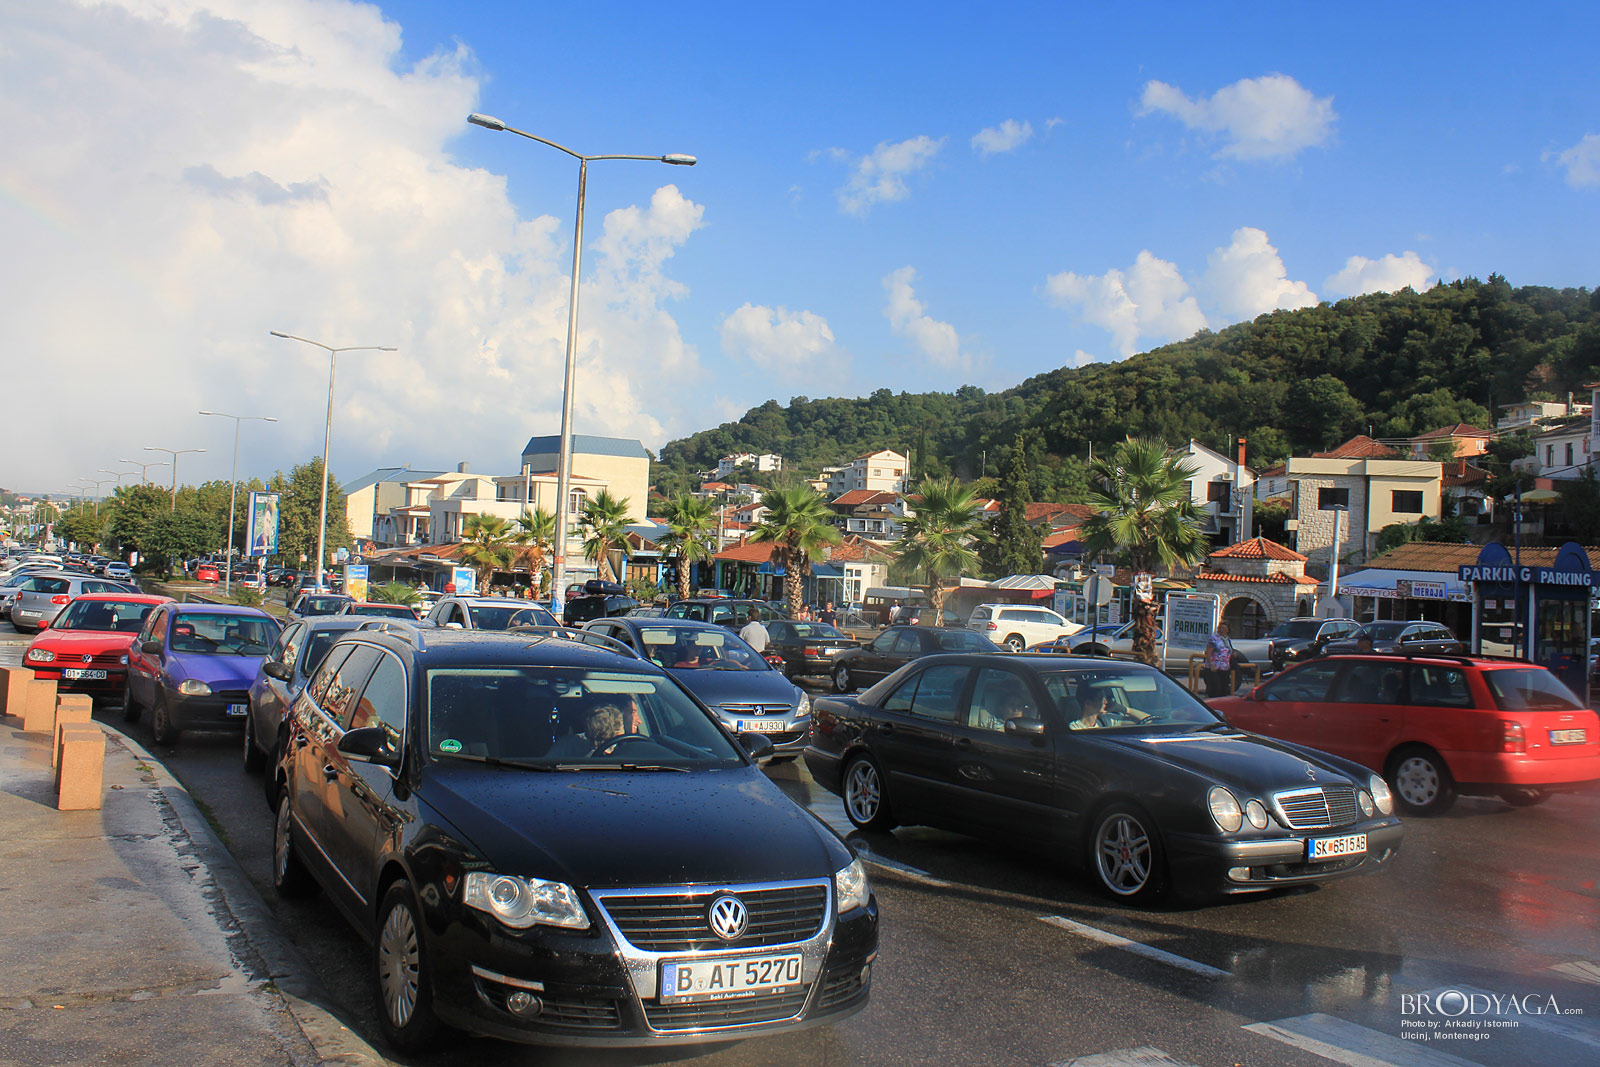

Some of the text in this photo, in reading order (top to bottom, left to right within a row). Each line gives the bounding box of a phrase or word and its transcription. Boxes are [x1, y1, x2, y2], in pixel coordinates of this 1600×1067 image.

[1462, 567, 1531, 581] PARKING
[1540, 571, 1591, 586] PARKING
[1414, 588, 1444, 598] MERAJA
[1174, 620, 1208, 634] PARKING
[744, 722, 754, 730] UL
[1316, 840, 1328, 856] SK
[677, 958, 800, 992] B AT 5270
